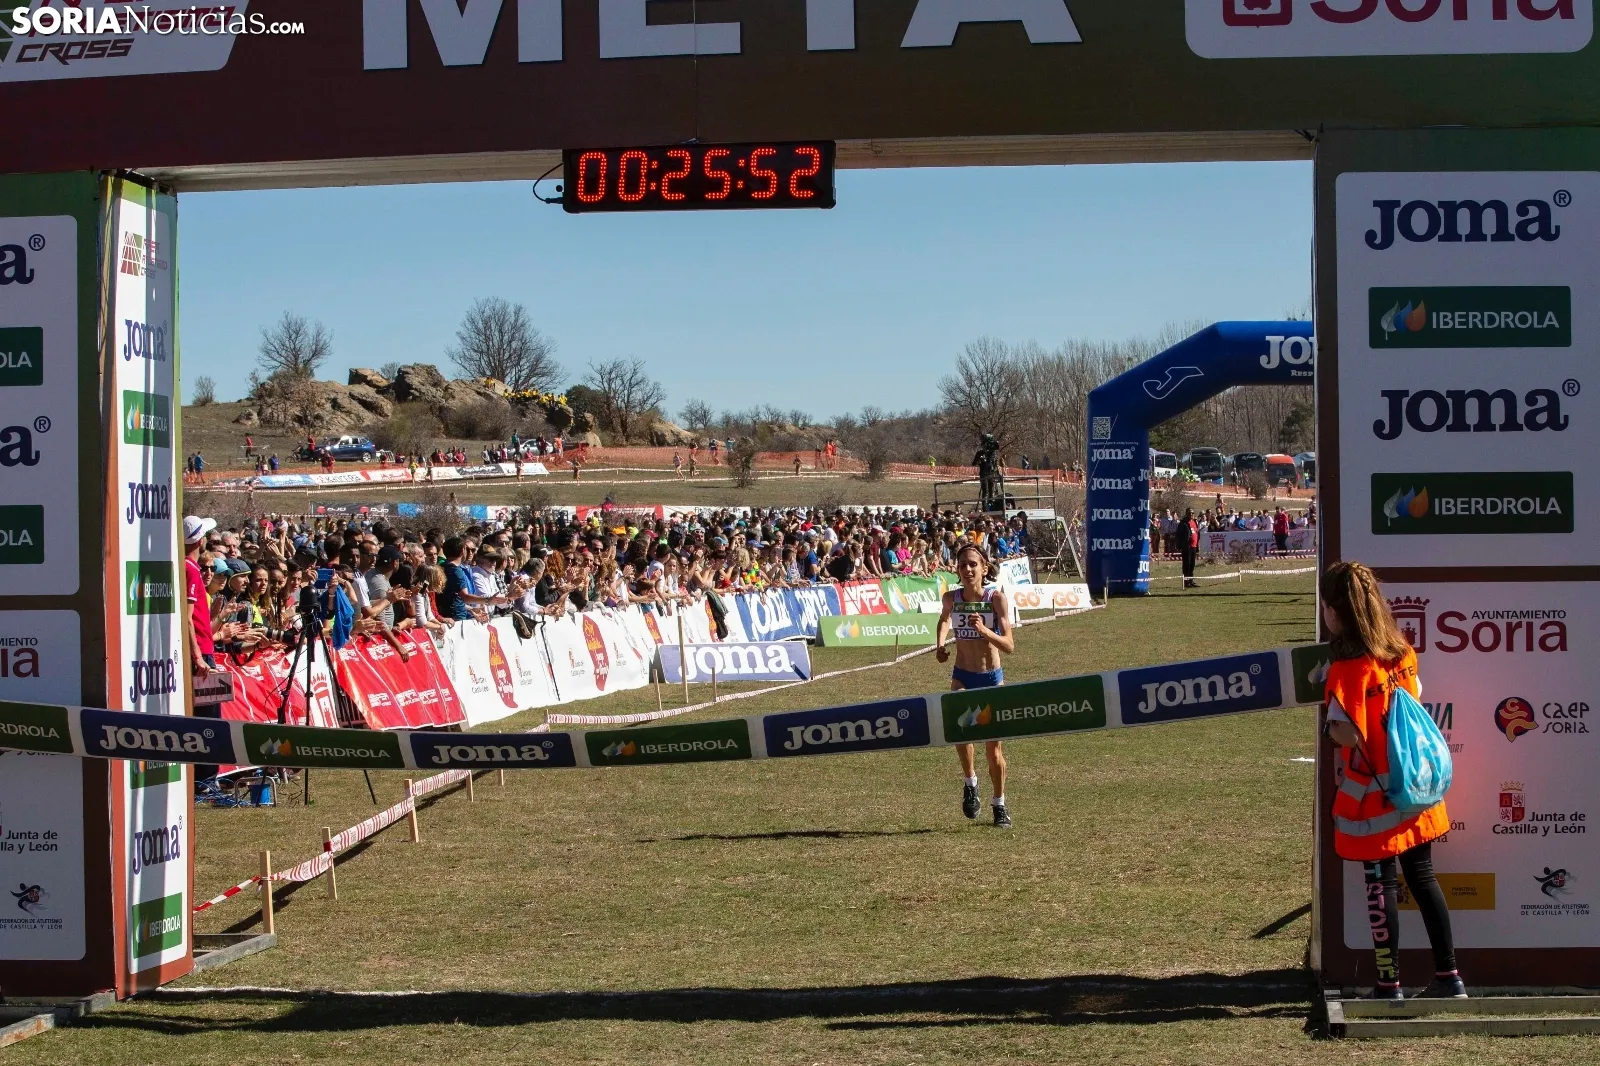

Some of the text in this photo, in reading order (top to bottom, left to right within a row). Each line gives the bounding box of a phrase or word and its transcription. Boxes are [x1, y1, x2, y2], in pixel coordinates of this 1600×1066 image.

[15, 38, 135, 65] CROSS
[1432, 310, 1560, 329] IBERDROLA
[1435, 496, 1562, 515] IBERDROLA
[1471, 609, 1567, 620] AYUNTAMIENTO
[862, 624, 930, 638] IBERDROLA
[1434, 610, 1568, 654] Soria
[996, 699, 1094, 723] IBERDROLA
[296, 745, 391, 759] IBERDROLA
[639, 738, 739, 755] IBERDROLA
[1529, 811, 1586, 823] Junta de
[5, 829, 58, 840] Junta de
[1492, 822, 1586, 837] Castilla y León
[18, 843, 26, 854] y
[29, 840, 58, 852] León
[149, 914, 181, 938] IBERDROLA
